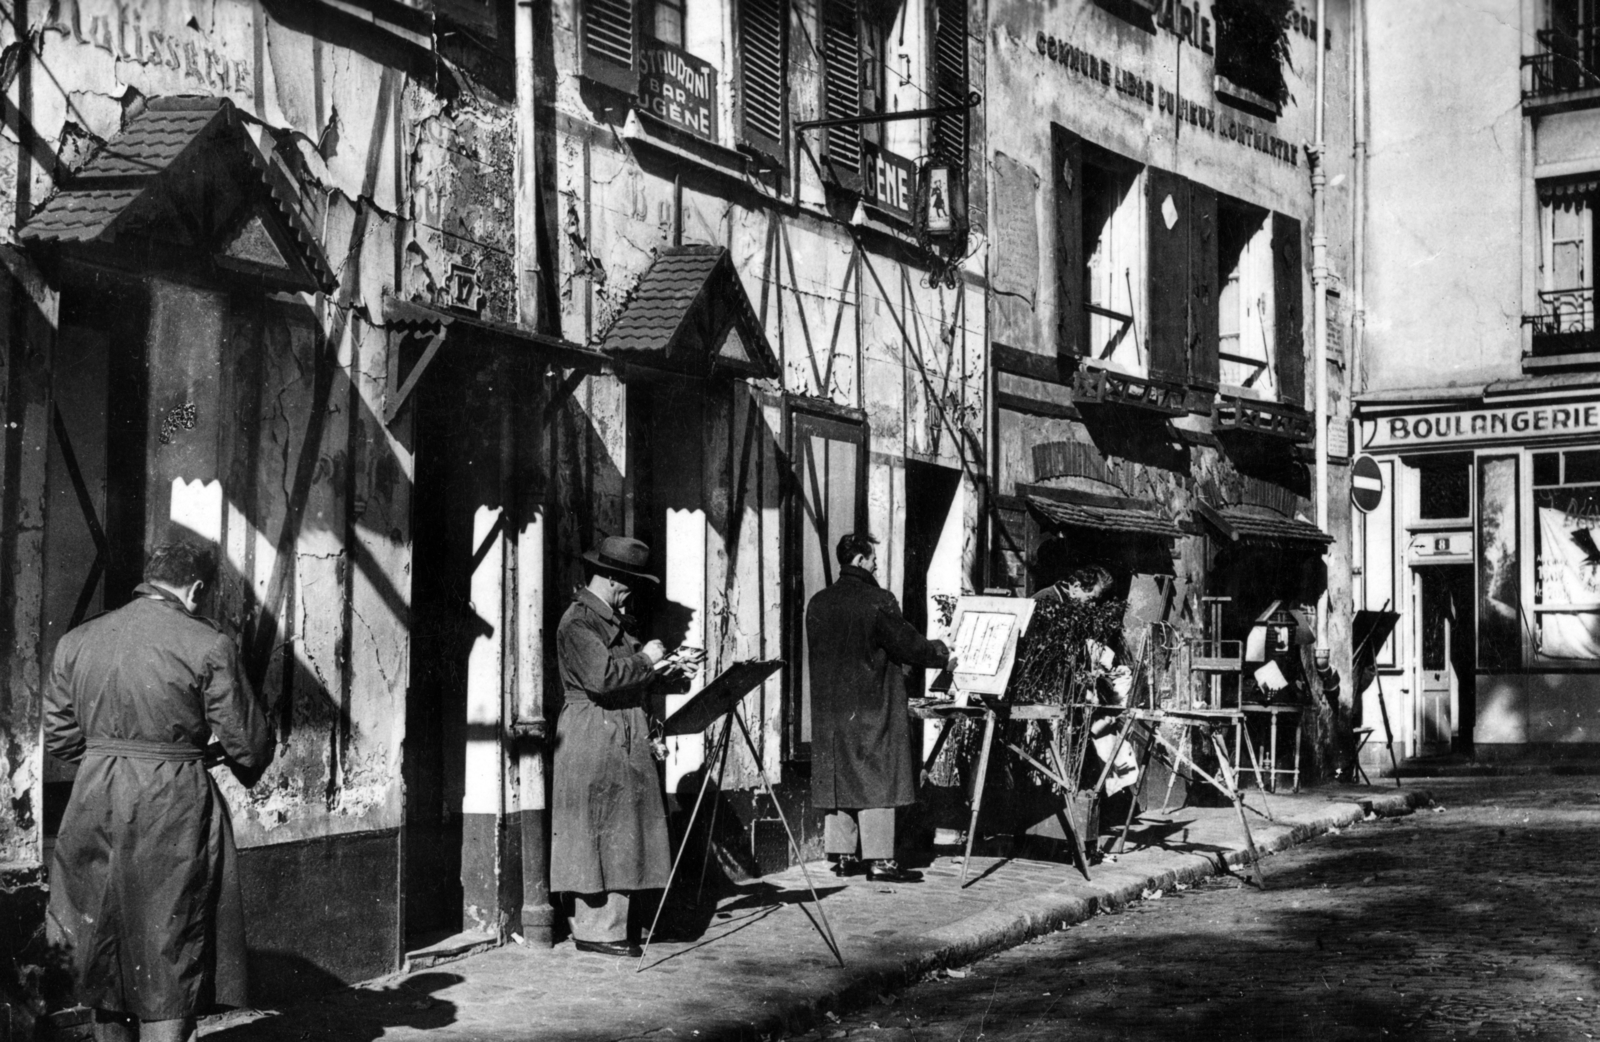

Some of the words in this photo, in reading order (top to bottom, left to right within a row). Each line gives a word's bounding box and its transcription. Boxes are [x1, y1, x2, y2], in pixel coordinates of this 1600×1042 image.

[639, 49, 710, 100] STAURANT
[650, 78, 686, 105] BAR
[637, 94, 710, 135] UGÈNE
[1036, 30, 1110, 86] COMMUNE
[1114, 66, 1154, 107] LIBRE
[1158, 85, 1175, 115] DU
[1219, 113, 1298, 166] MONTMARTRE
[865, 152, 909, 212] GÈNE
[455, 273, 475, 306] 17
[1386, 405, 1599, 441] BOULANGERIE
